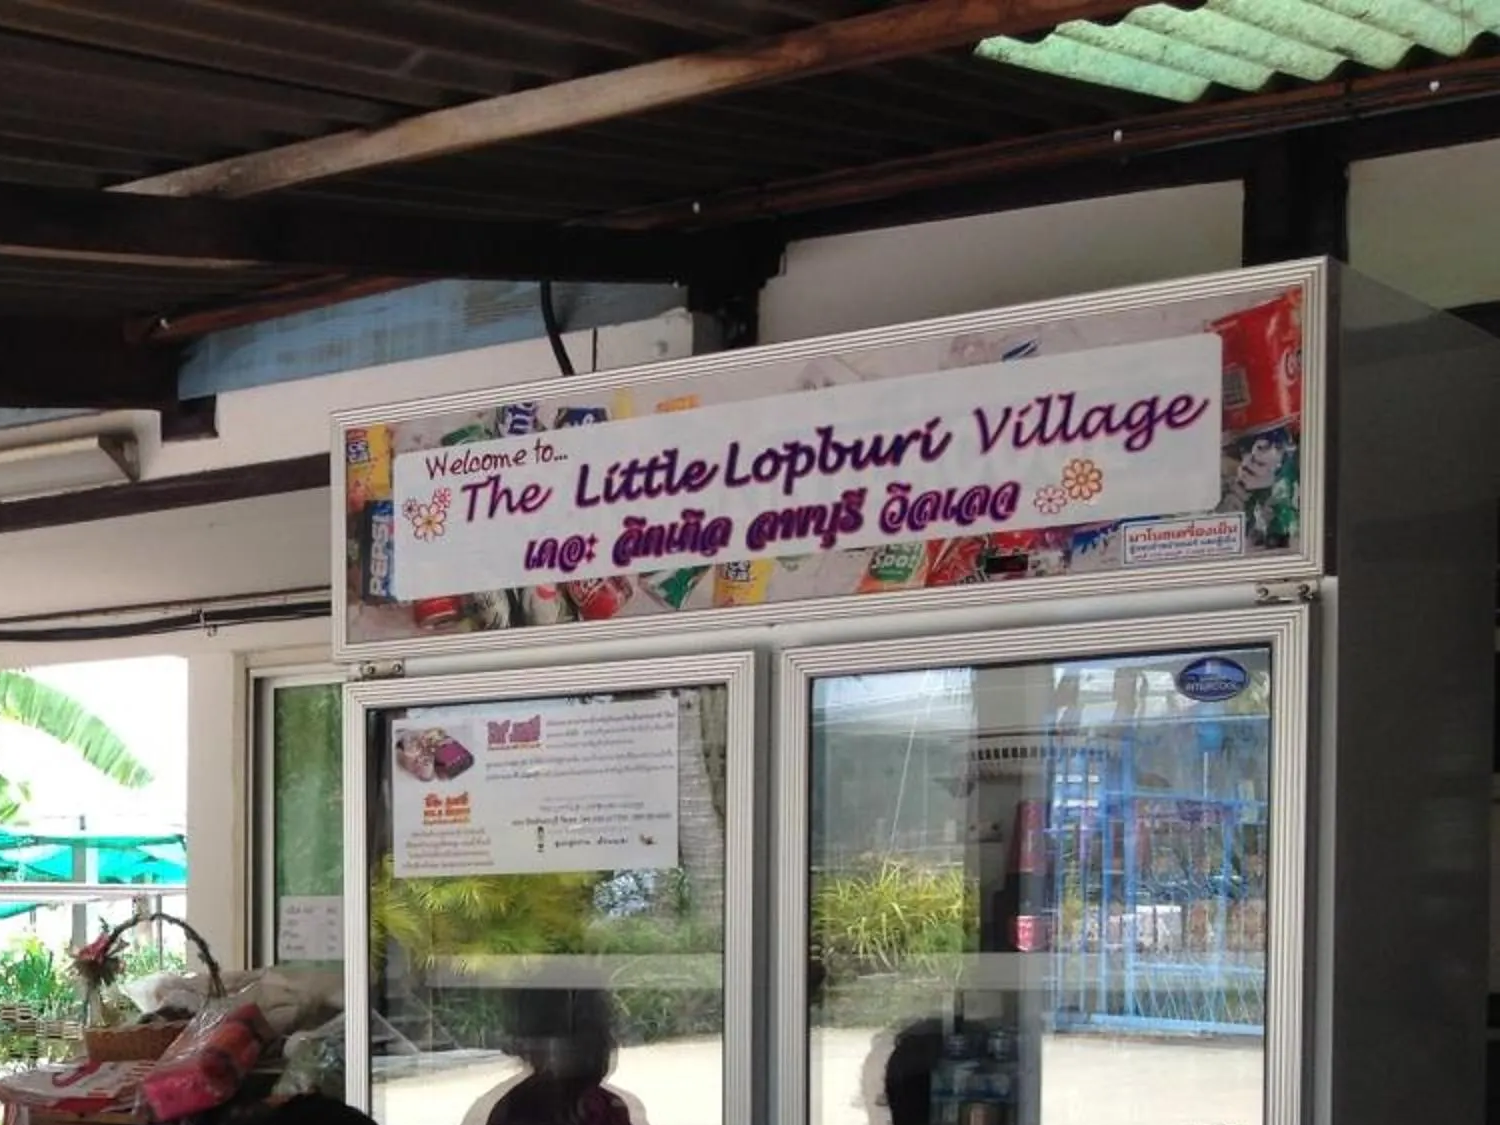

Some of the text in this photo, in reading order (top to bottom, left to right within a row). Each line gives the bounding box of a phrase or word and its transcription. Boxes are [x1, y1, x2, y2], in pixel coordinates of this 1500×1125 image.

[425, 438, 569, 480] Welcome to...
[461, 391, 1211, 522] The Little Lopburi Village
[524, 532, 599, 573] เดอะ
[746, 487, 868, 551] ลพบุรี
[879, 481, 1021, 534] วิลเลจ
